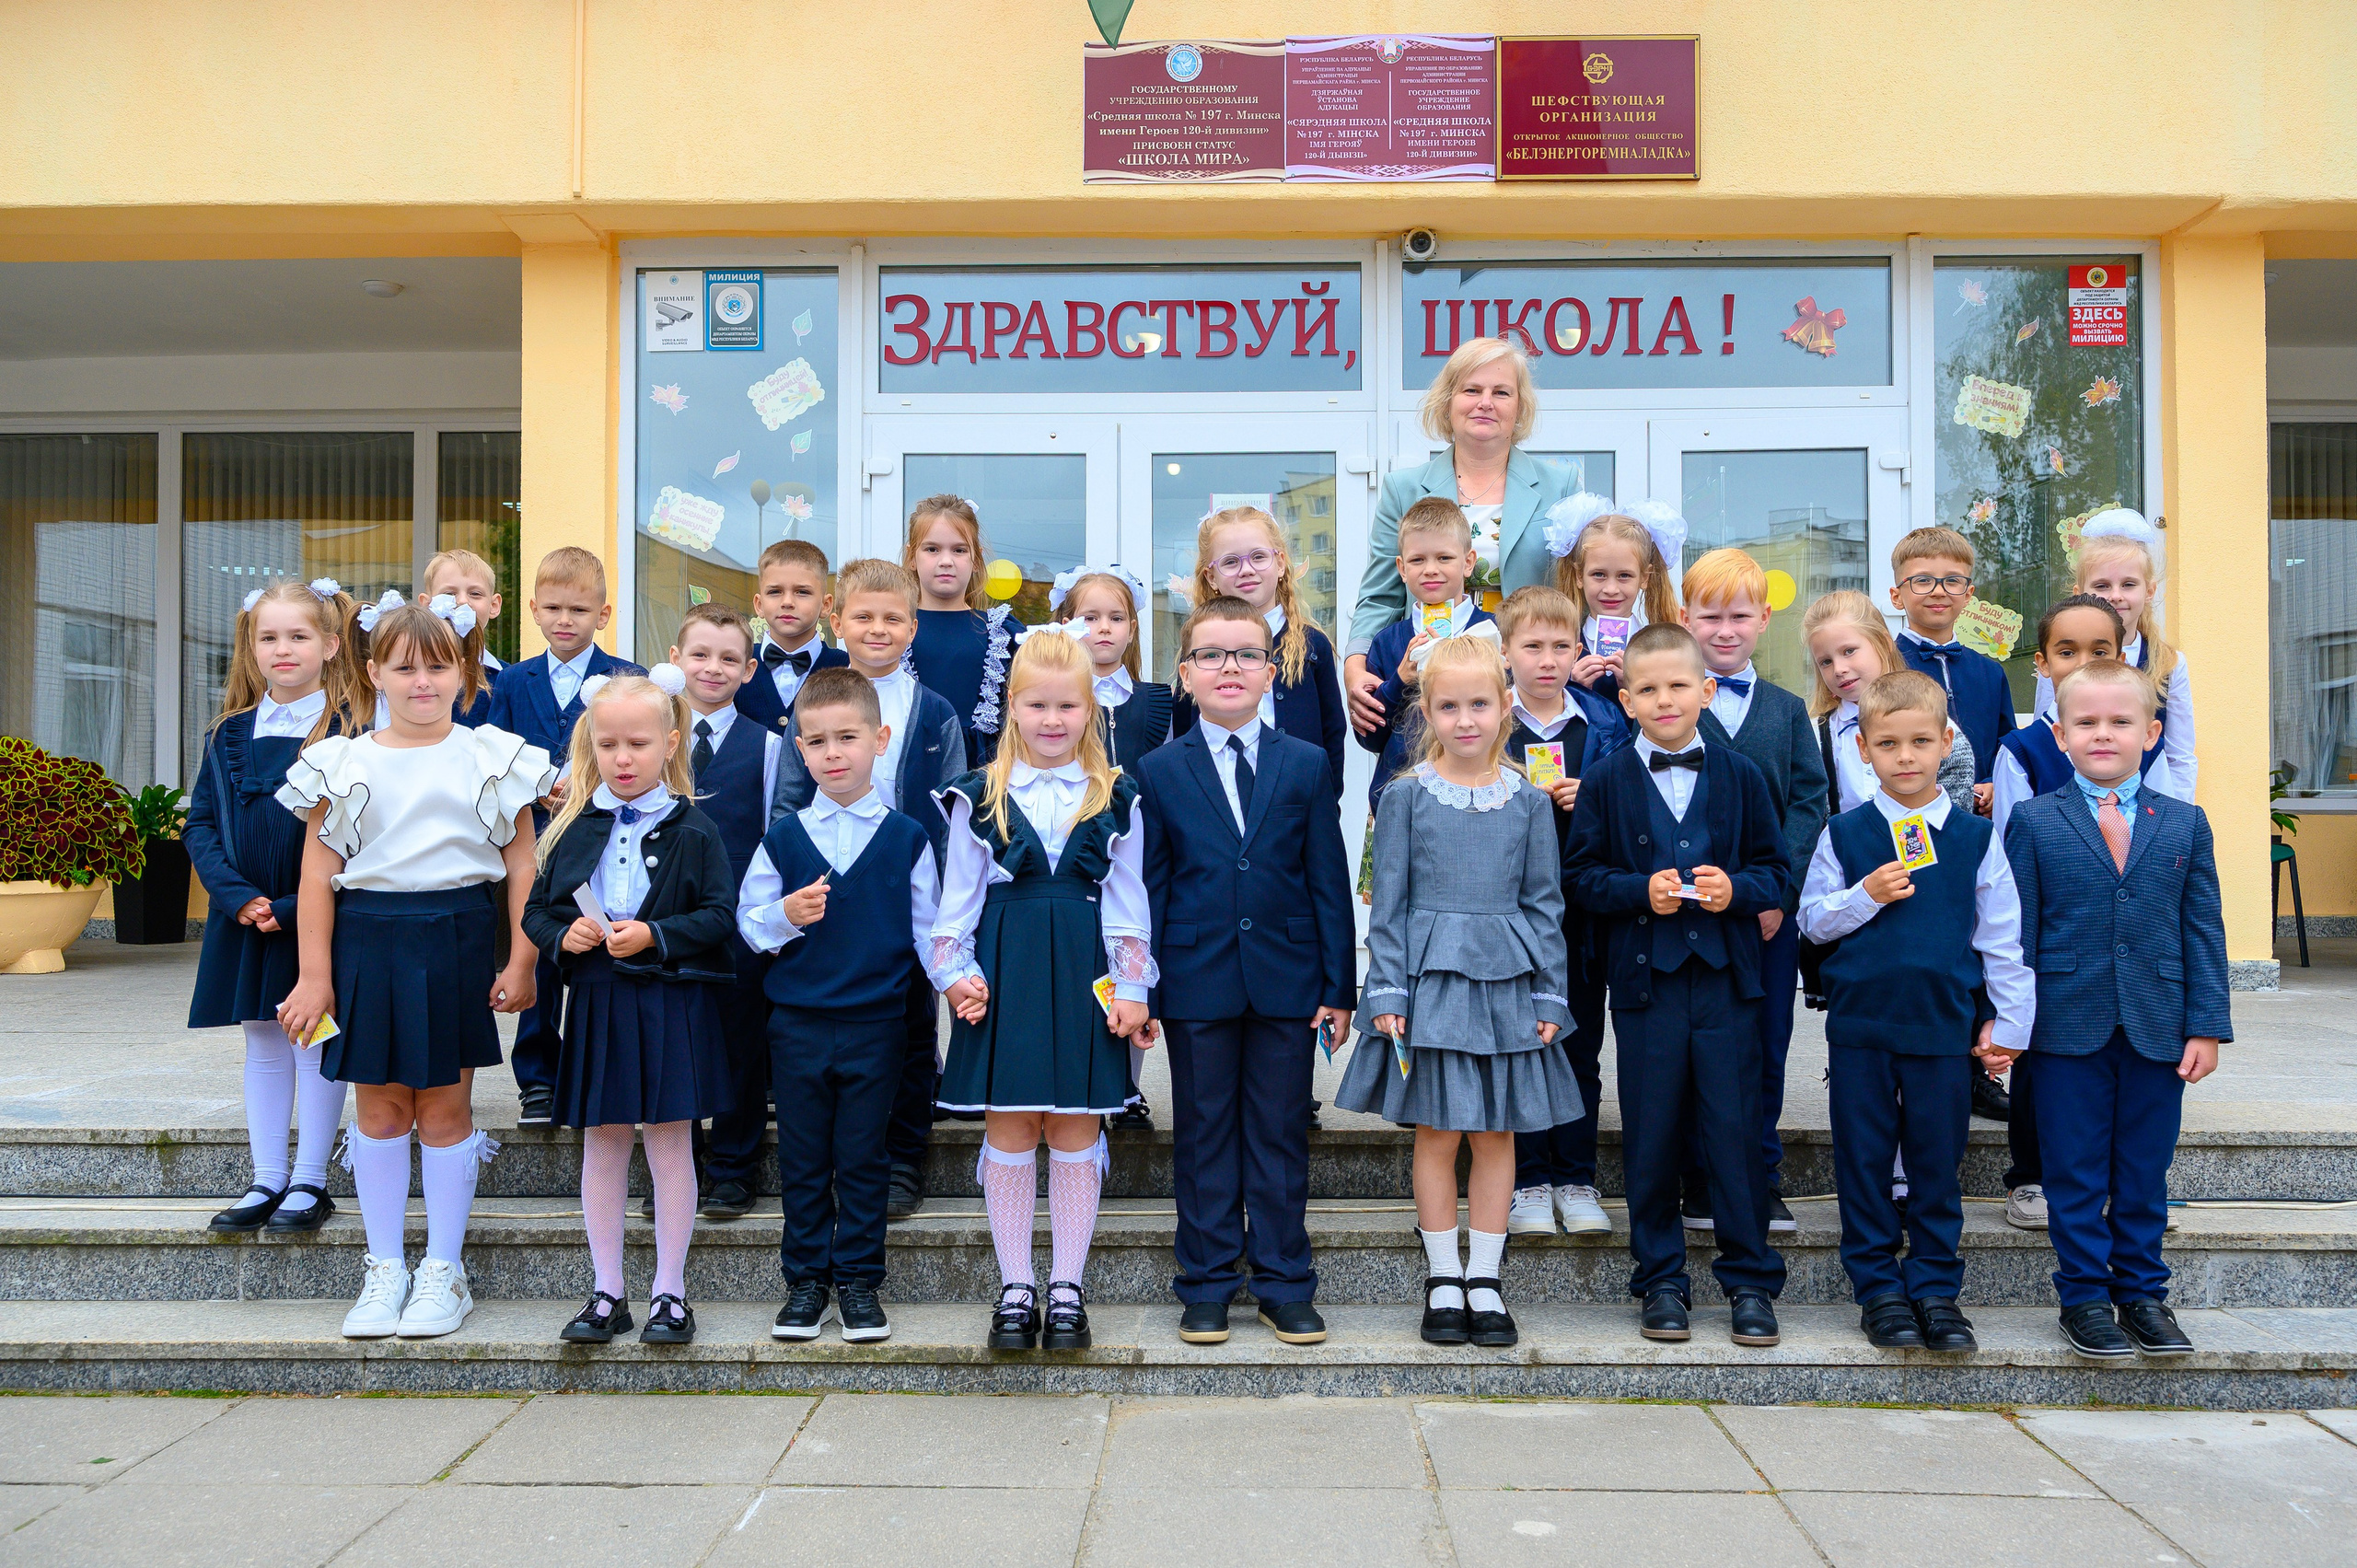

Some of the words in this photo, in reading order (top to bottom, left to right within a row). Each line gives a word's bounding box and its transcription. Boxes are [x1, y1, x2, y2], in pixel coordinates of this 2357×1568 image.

[1131, 85, 1238, 94] ГОСУДАРСТВЕННОМУ
[1311, 88, 1364, 97] ДЗЯРЖАЎНАЯ
[1408, 88, 1480, 97] ГОСУДАРСТВЕННОЕ
[1109, 97, 1183, 105] УЧРЕЖДЕНИЮ
[1185, 96, 1259, 105] ОБРАЗОВАНИЯ
[1531, 95, 1666, 108] ШЕФСТВУЮЩАЯ
[1087, 110, 1142, 122] «Средняя
[1144, 112, 1181, 121] школа
[1201, 110, 1222, 120] 197
[1237, 110, 1282, 120] Минска
[1539, 111, 1657, 123] ОРГАНИЗАЦИЯ
[1287, 118, 1346, 127] «СЯРЭДНЯЯ
[1349, 118, 1387, 126] ШКОЛА
[1393, 117, 1449, 127] «СРЕДНЯЯ
[1451, 117, 1492, 125] ШКОЛА
[1099, 128, 1136, 136] имени
[1139, 125, 1179, 136] Героев
[1182, 125, 1212, 135] 120-й
[1214, 127, 1269, 136] дивизии»
[1337, 130, 1379, 138] МІНСКА
[1440, 129, 1486, 137] МИНСКА
[1565, 133, 1630, 141] АКЦИОНЕРНОЕ
[1635, 133, 1684, 141] ОБЩЕСТВО
[1132, 142, 1192, 150] ПРИСВОЕН
[1195, 141, 1236, 150] СТАТУС
[1328, 139, 1363, 147] ГЕРОЯЎ
[1305, 150, 1326, 159] 120-Й
[1406, 149, 1427, 158] 120-Й
[1506, 146, 1691, 161] «БЕЛЭНЕРГОРЕМНАЛАДКА»
[1118, 153, 1190, 166] «ШКОЛА
[1194, 153, 1250, 166] МИРА»
[709, 273, 761, 282] МИЛИЦИЯ
[2073, 308, 2123, 323] ЗДЕСЬ
[884, 281, 1357, 371] ЗДРАВСТВУЙ,
[2072, 334, 2125, 344] МИЛИЦИЮ
[767, 370, 790, 387] Буду
[1972, 378, 2014, 401] Вперёд
[1970, 394, 2020, 413] знаниям!
[679, 507, 714, 525] осенние
[1979, 602, 2003, 620] Буду
[1960, 610, 2016, 633] отличником!
